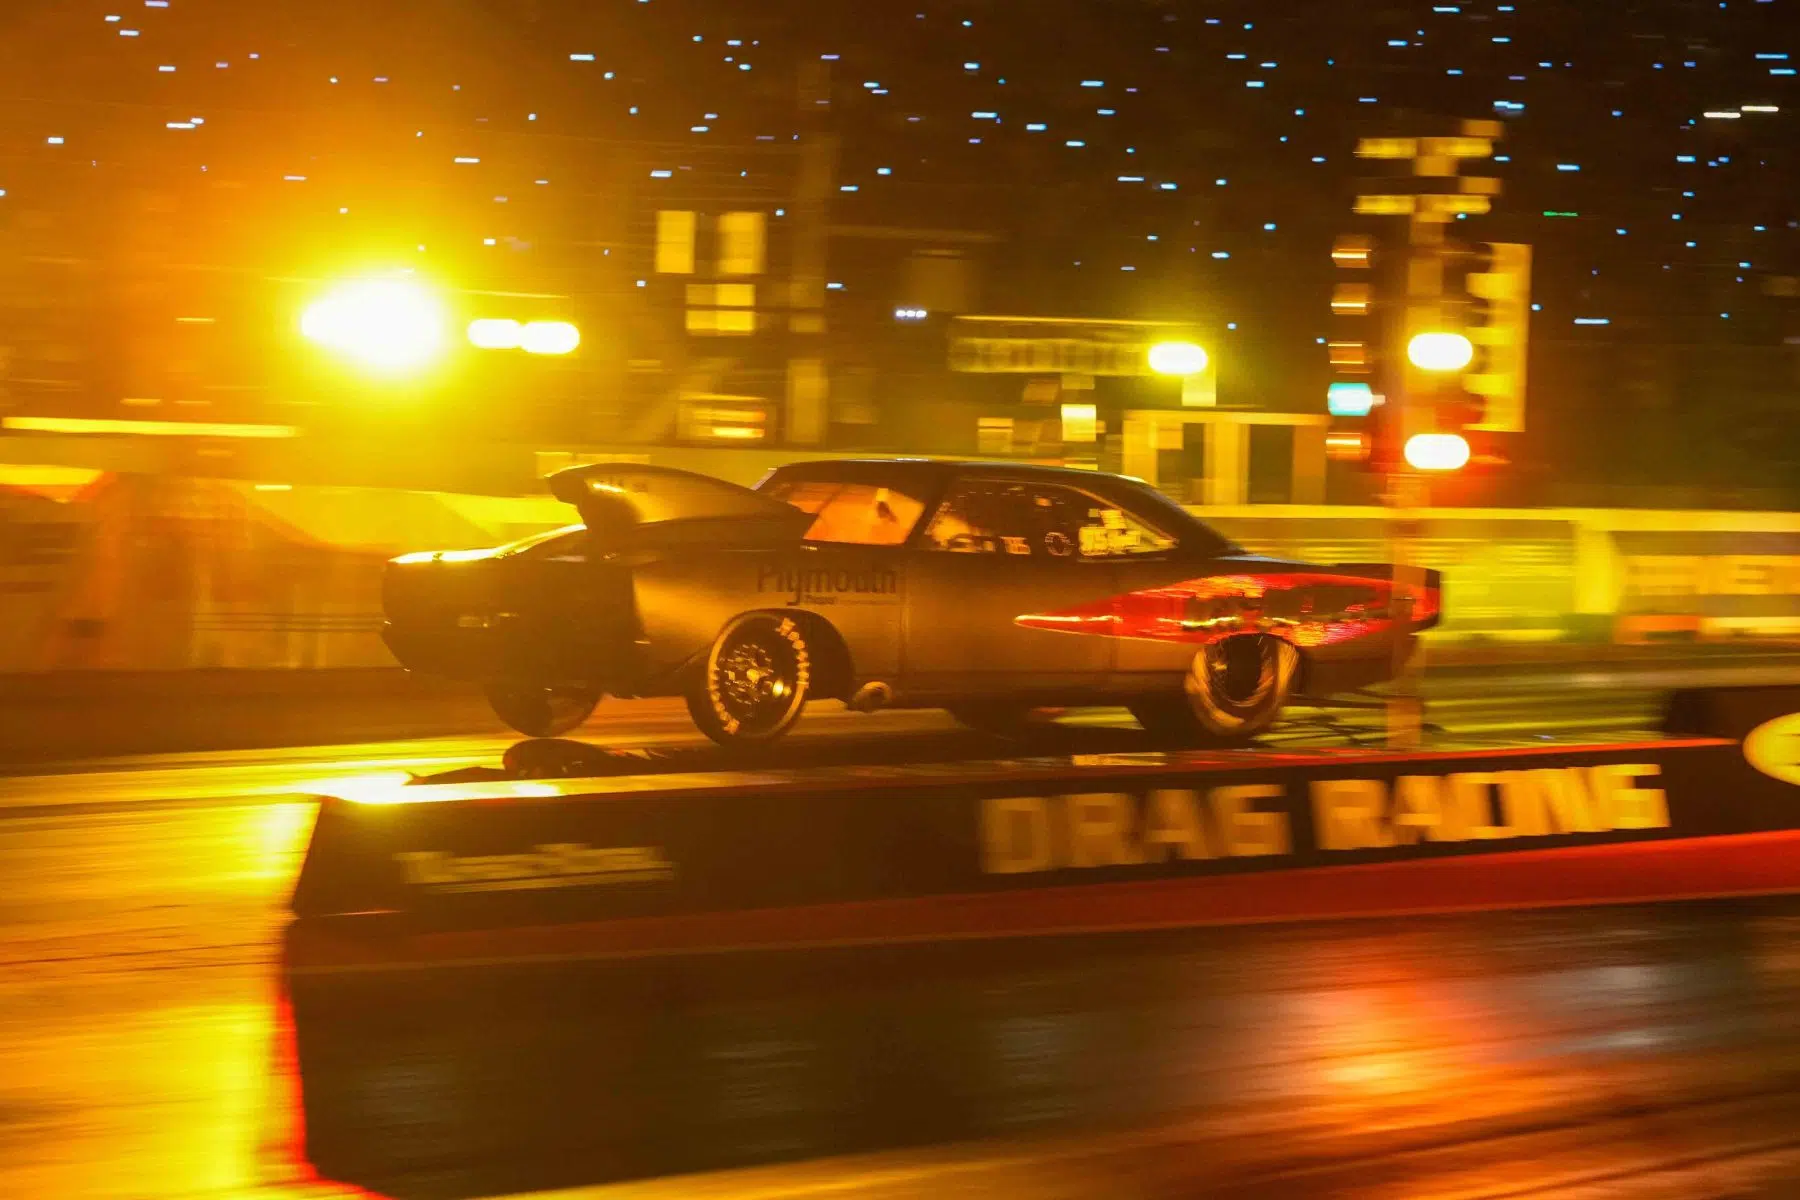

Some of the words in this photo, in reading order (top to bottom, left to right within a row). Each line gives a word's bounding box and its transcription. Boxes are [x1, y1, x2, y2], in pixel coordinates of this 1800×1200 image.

[756, 562, 898, 606] Plymouth
[979, 784, 1292, 874] DRAG
[1309, 763, 1671, 850] RACING
